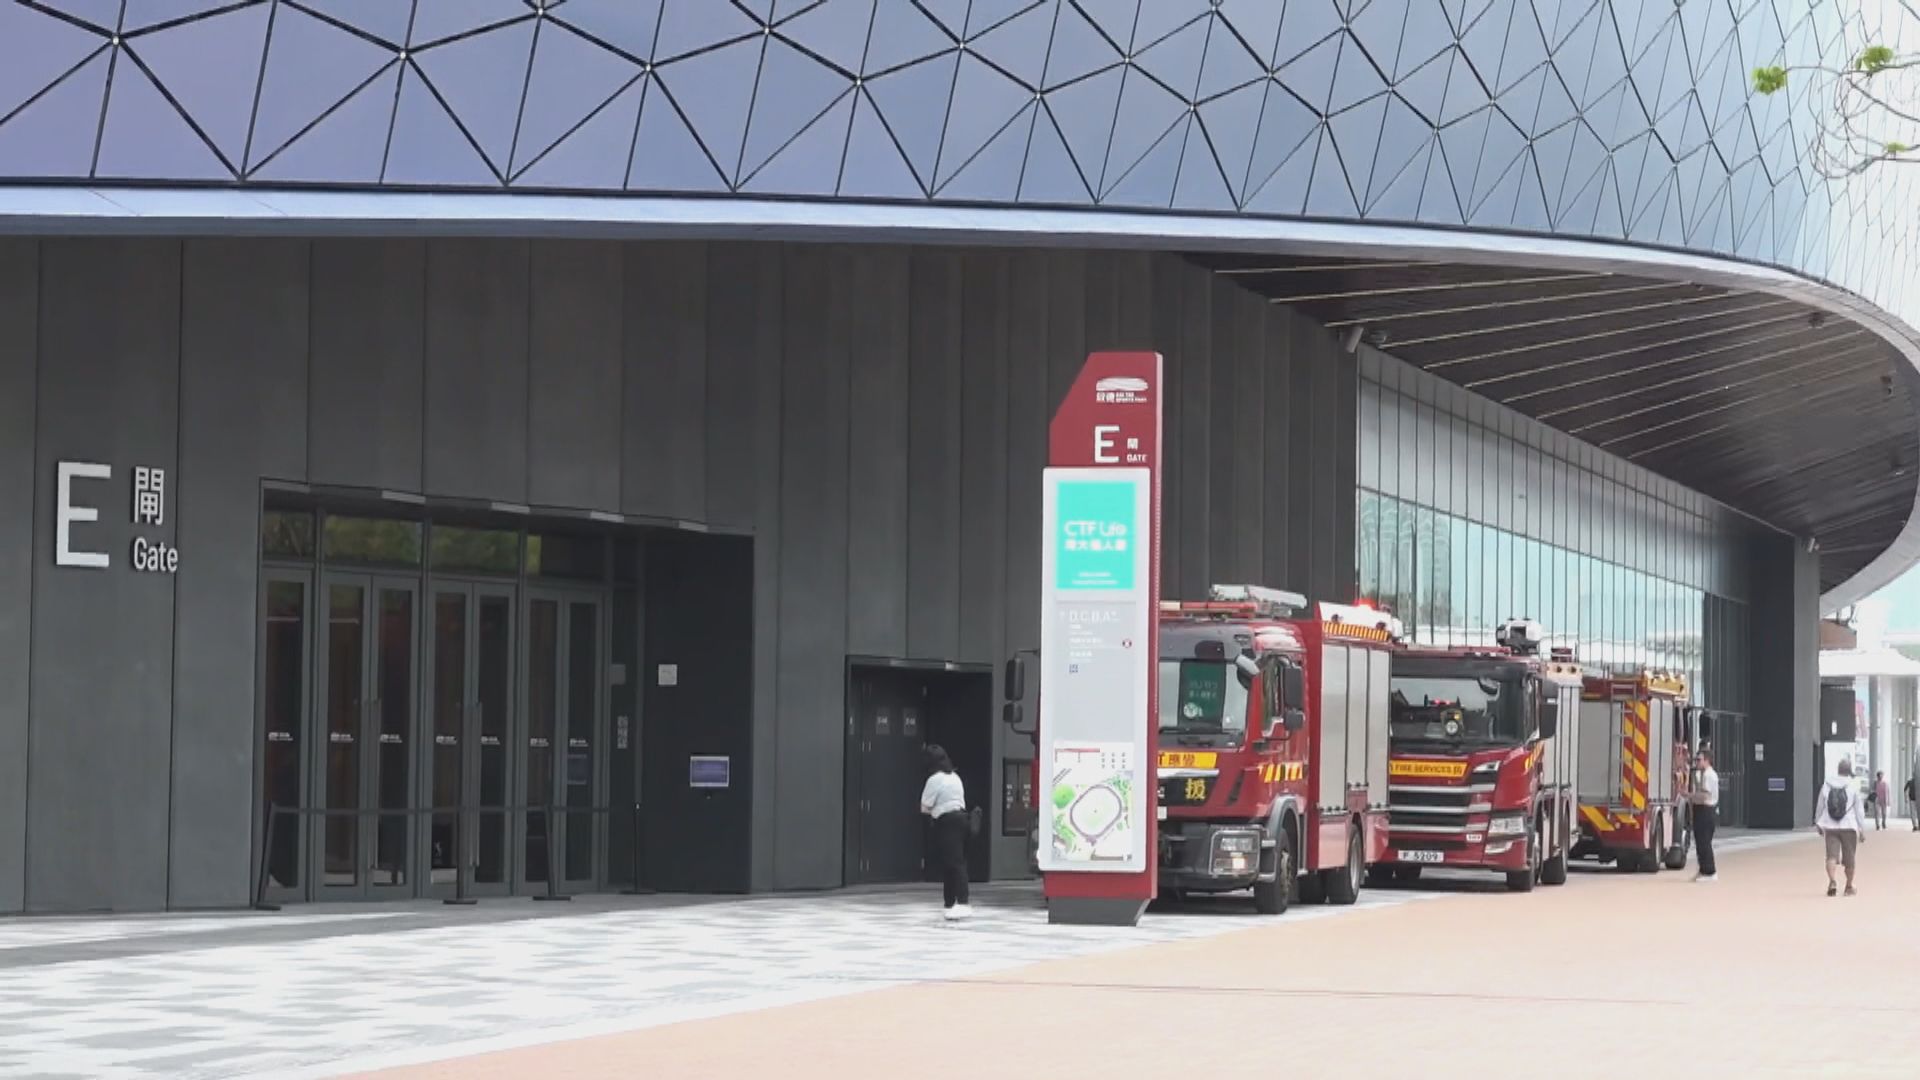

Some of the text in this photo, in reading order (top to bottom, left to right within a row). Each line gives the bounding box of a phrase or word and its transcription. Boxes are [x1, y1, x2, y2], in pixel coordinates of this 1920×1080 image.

[1094, 425, 1120, 463] E
[1126, 454, 1147, 463] GATE
[56, 461, 112, 568] E
[134, 466, 164, 526] 閘
[1064, 520, 1097, 536] CTF
[133, 536, 178, 573] Gate
